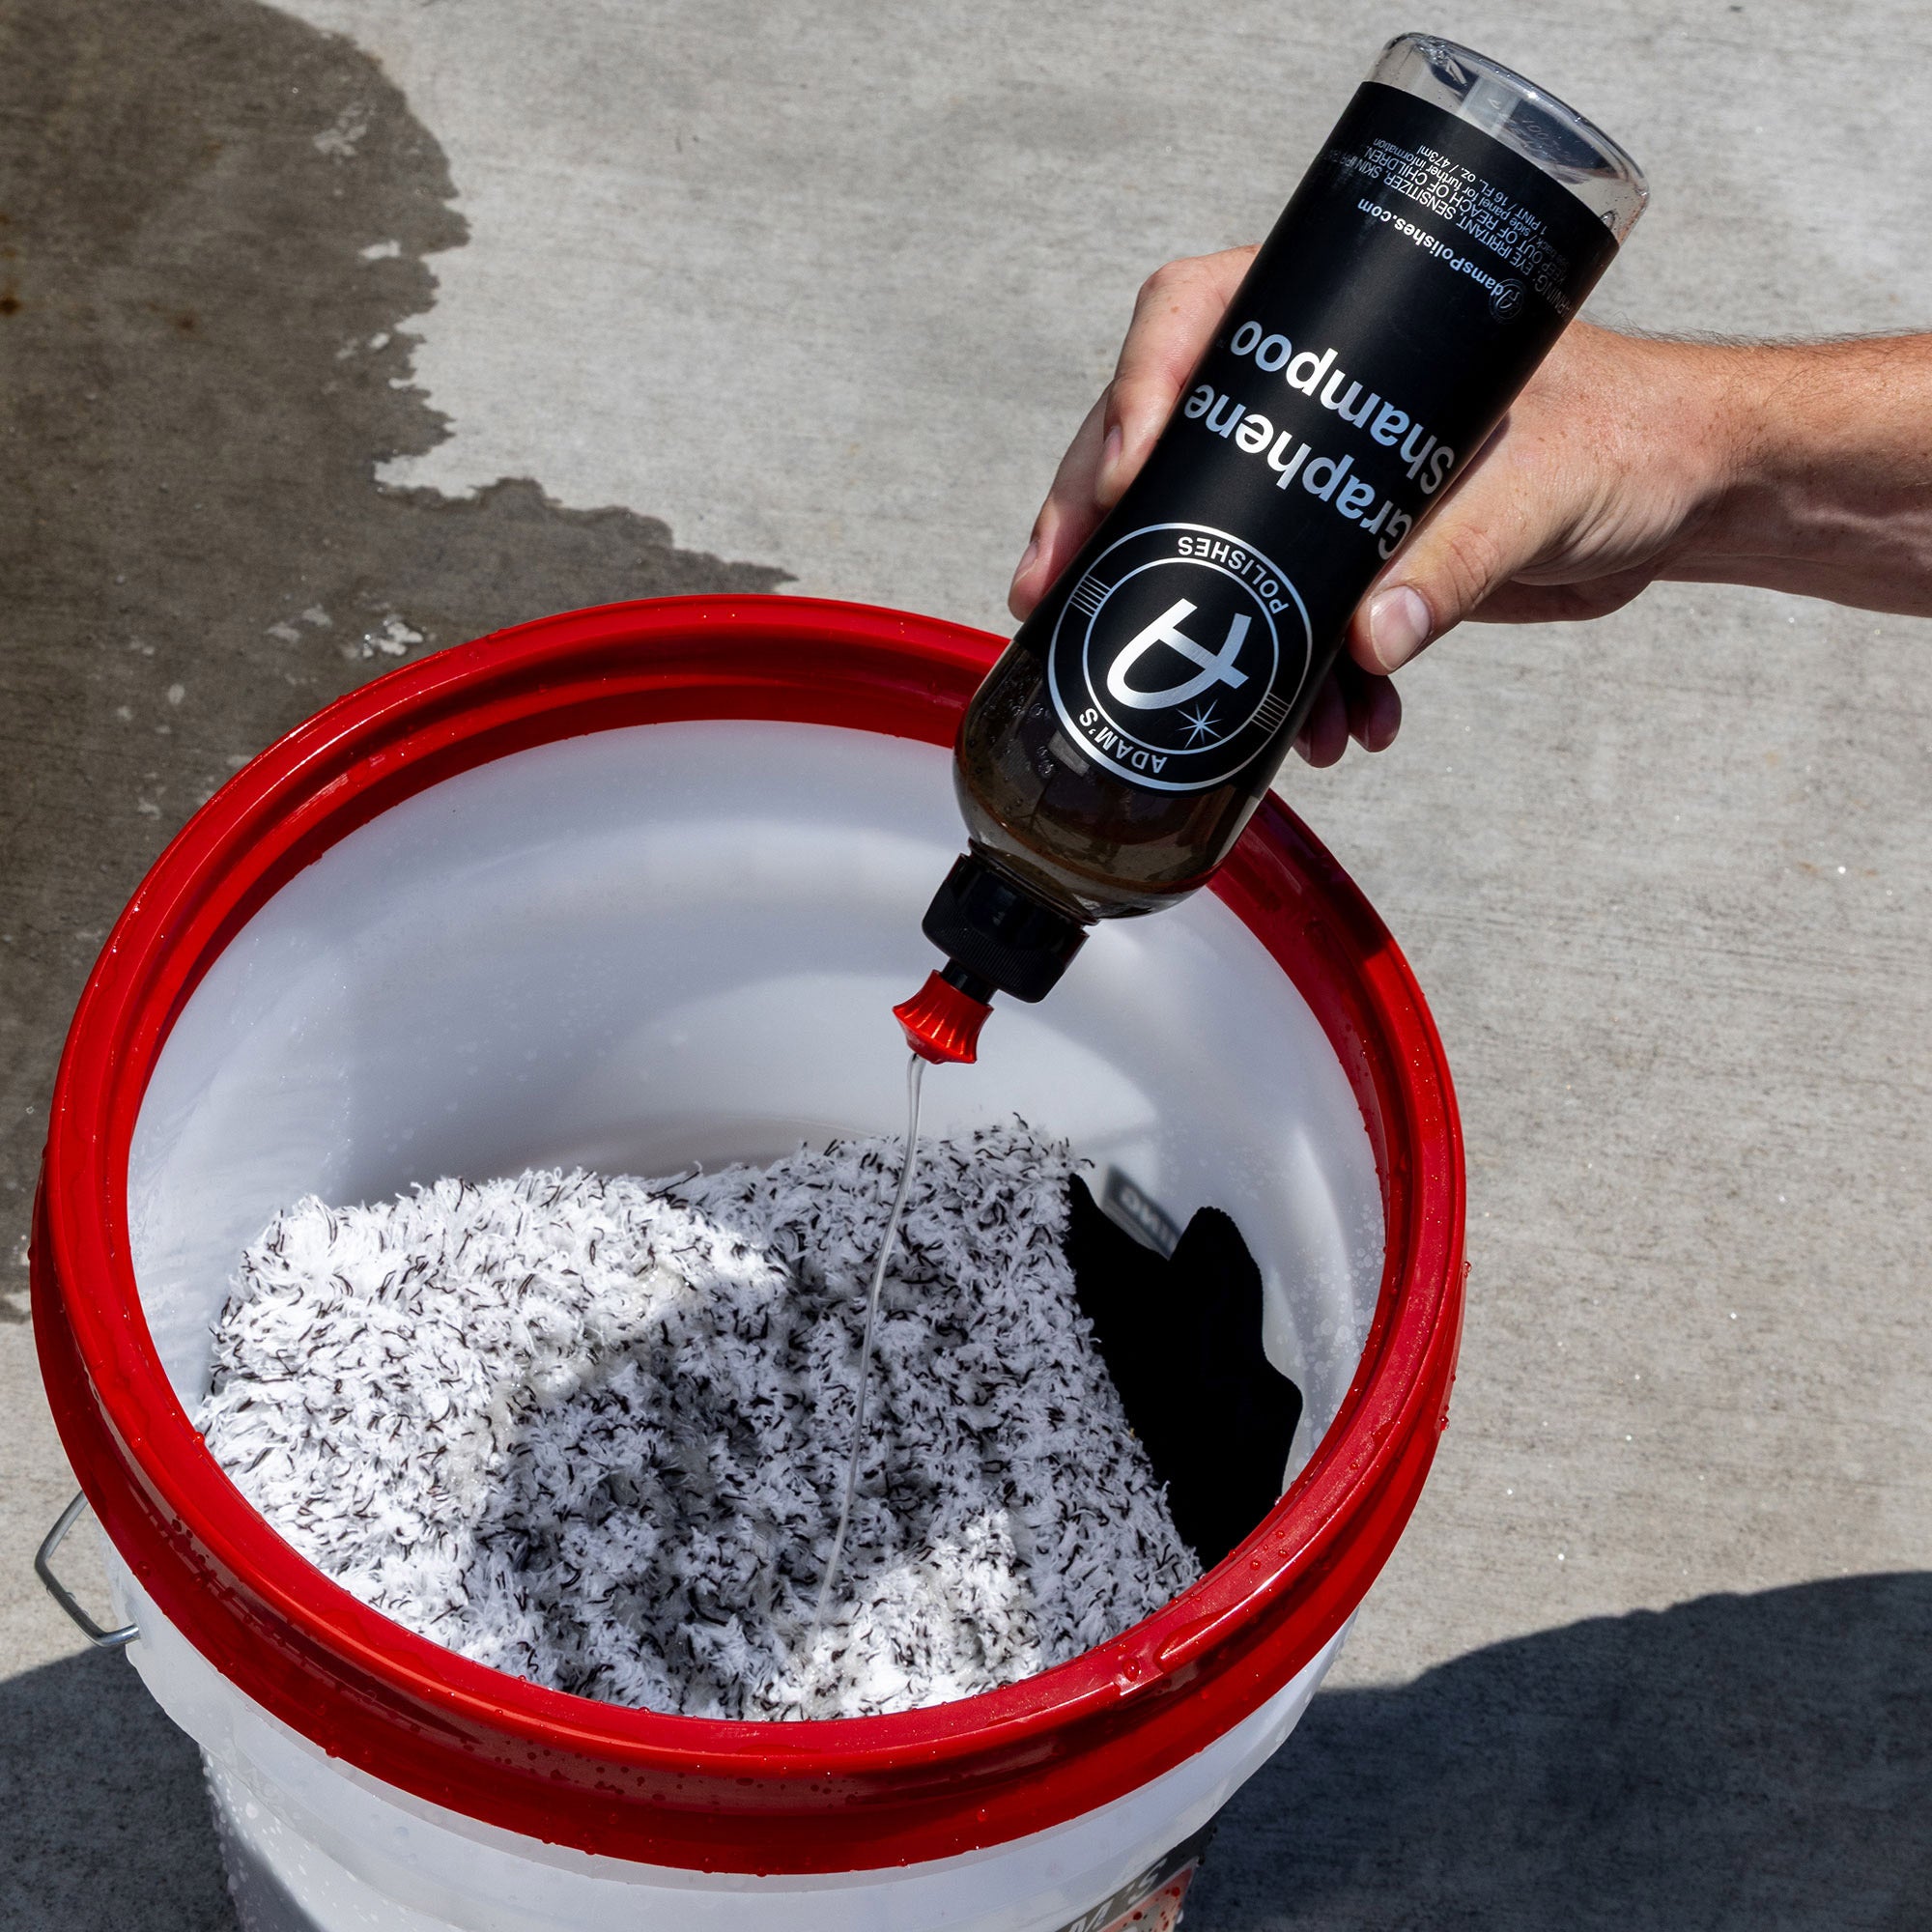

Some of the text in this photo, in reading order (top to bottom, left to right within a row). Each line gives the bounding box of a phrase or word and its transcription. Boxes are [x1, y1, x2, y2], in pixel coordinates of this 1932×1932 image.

[1363, 144, 1430, 186] CHILDREN.
[1372, 135, 1427, 170] information
[1415, 143, 1452, 170] 473ml
[1353, 156, 1383, 179] SKIN
[1424, 162, 1463, 191] further
[1458, 166, 1477, 183] oz.
[1426, 177, 1451, 199] OF
[1460, 184, 1479, 202] for
[1474, 178, 1495, 197] FL.
[1492, 189, 1510, 207] 16
[1449, 190, 1499, 230] REACH
[1478, 196, 1511, 221] panel
[1513, 205, 1542, 230] PINT
[1455, 212, 1513, 259] IRRITANT,
[1496, 222, 1520, 244] OF
[1507, 215, 1532, 238] side
[1539, 224, 1548, 235] 1
[1509, 250, 1534, 275] EYE
[1515, 238, 1545, 264] OUT
[1529, 269, 1575, 318] ARNING:
[1230, 321, 1455, 495] Shampoo
[1183, 384, 1412, 560] Graphene
[1178, 536, 1289, 615] POLISHES
[1079, 707, 1168, 773] ADAM'S
